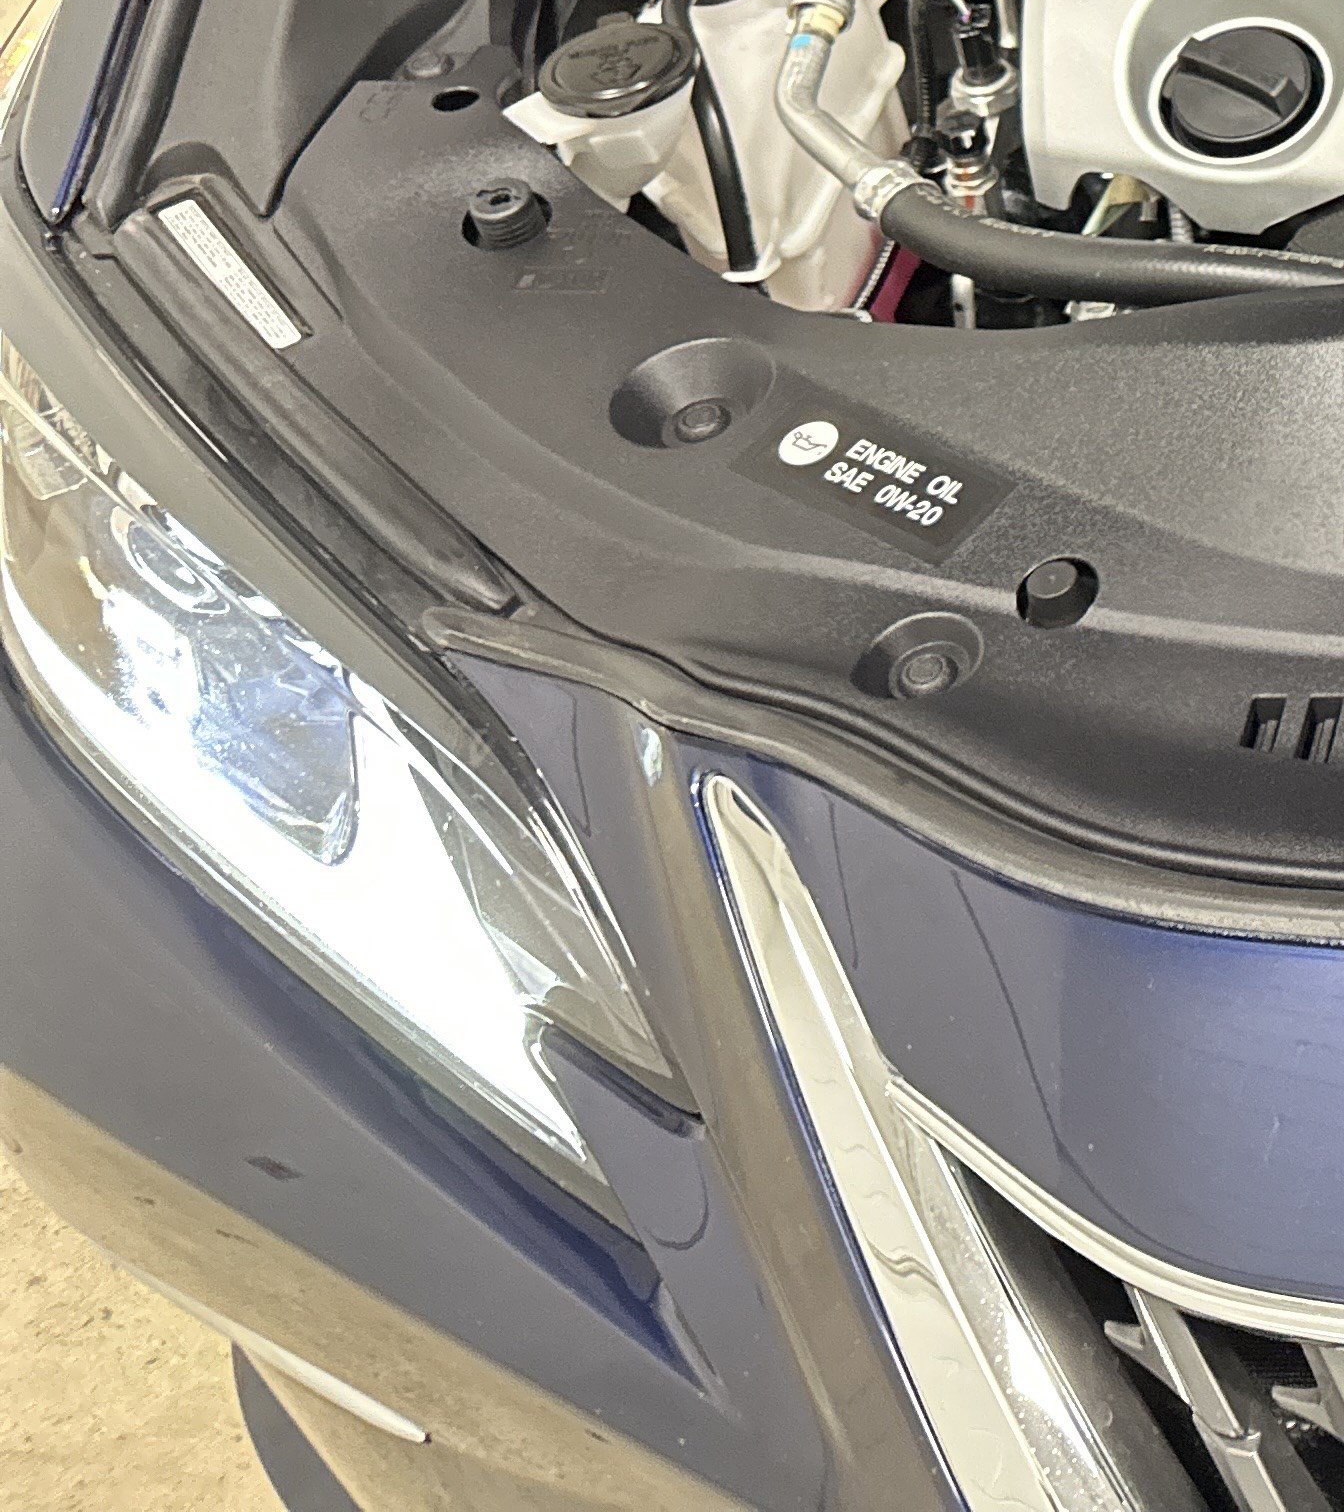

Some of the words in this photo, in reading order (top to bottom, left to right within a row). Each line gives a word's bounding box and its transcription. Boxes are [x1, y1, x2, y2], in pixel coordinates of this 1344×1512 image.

[823, 461, 875, 494] SAE
[873, 483, 944, 527] 0W-20
[845, 438, 928, 485] ENGINE
[927, 474, 964, 505] OIL
